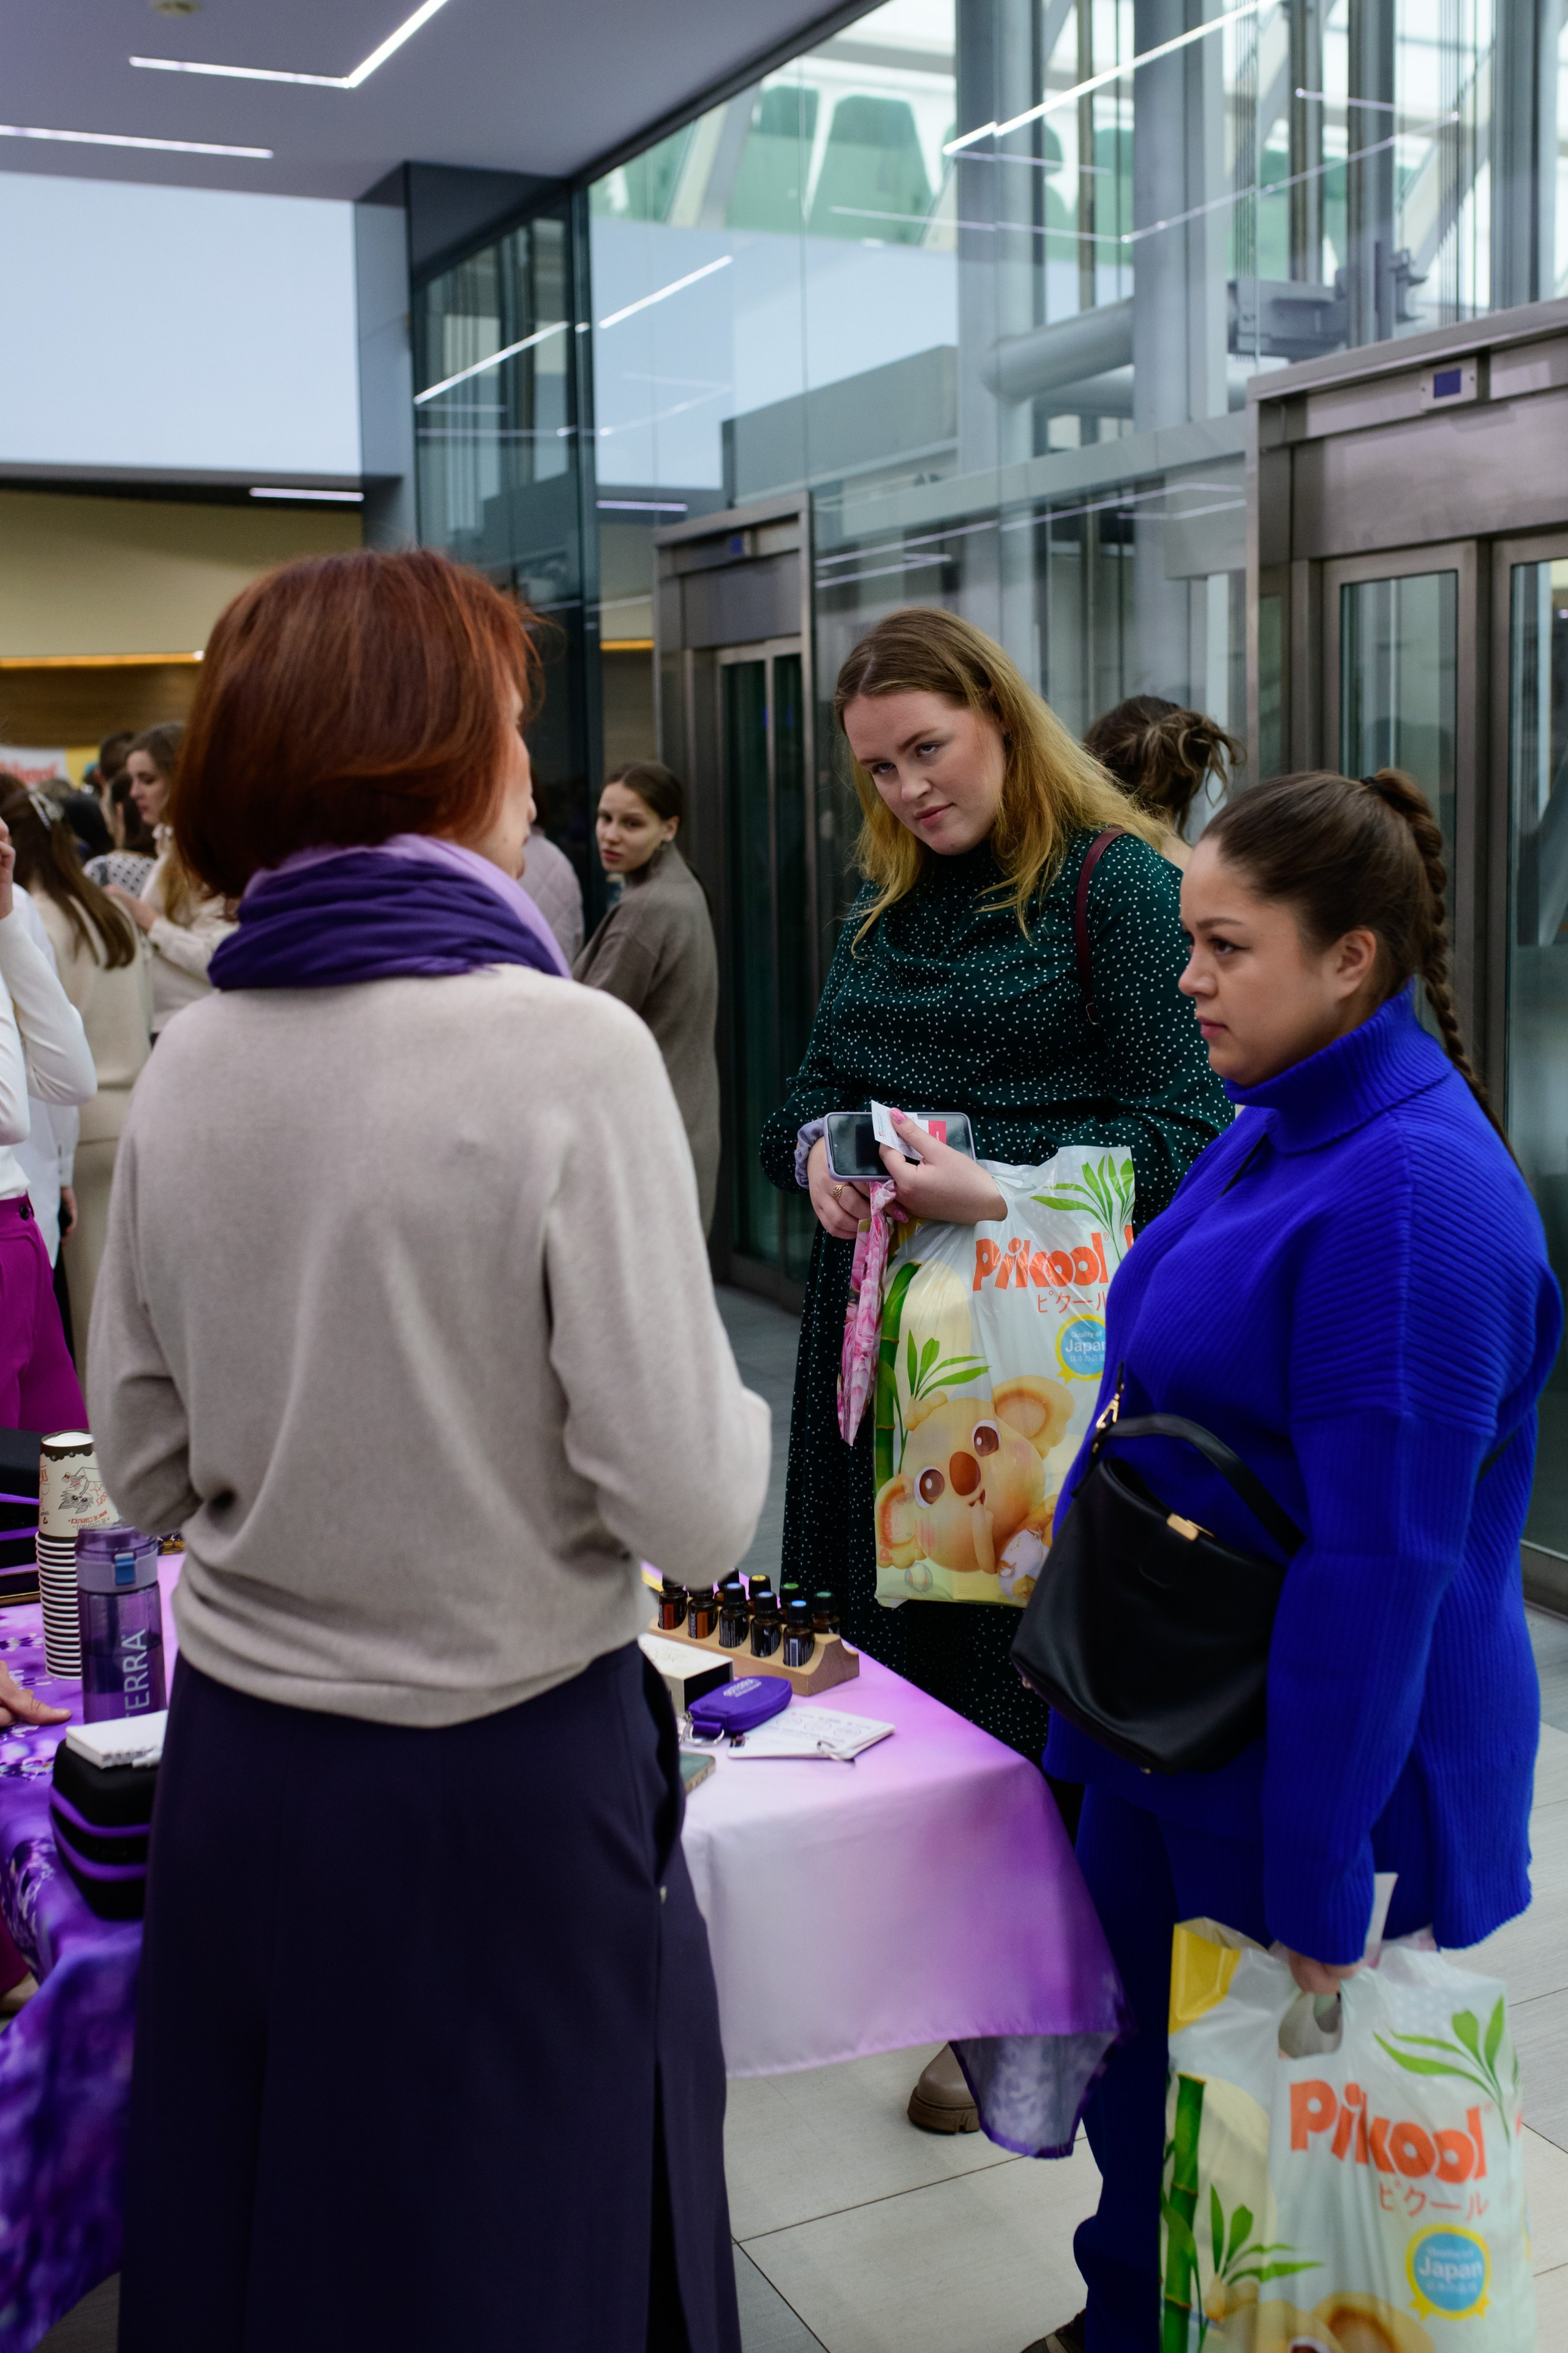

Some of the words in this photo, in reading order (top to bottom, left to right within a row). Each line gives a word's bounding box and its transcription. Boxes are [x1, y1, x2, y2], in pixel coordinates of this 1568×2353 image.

[973, 1233, 1109, 1291] Pikool
[121, 1628, 150, 1718] ERRA
[1289, 2078, 1487, 2185] Pikool
